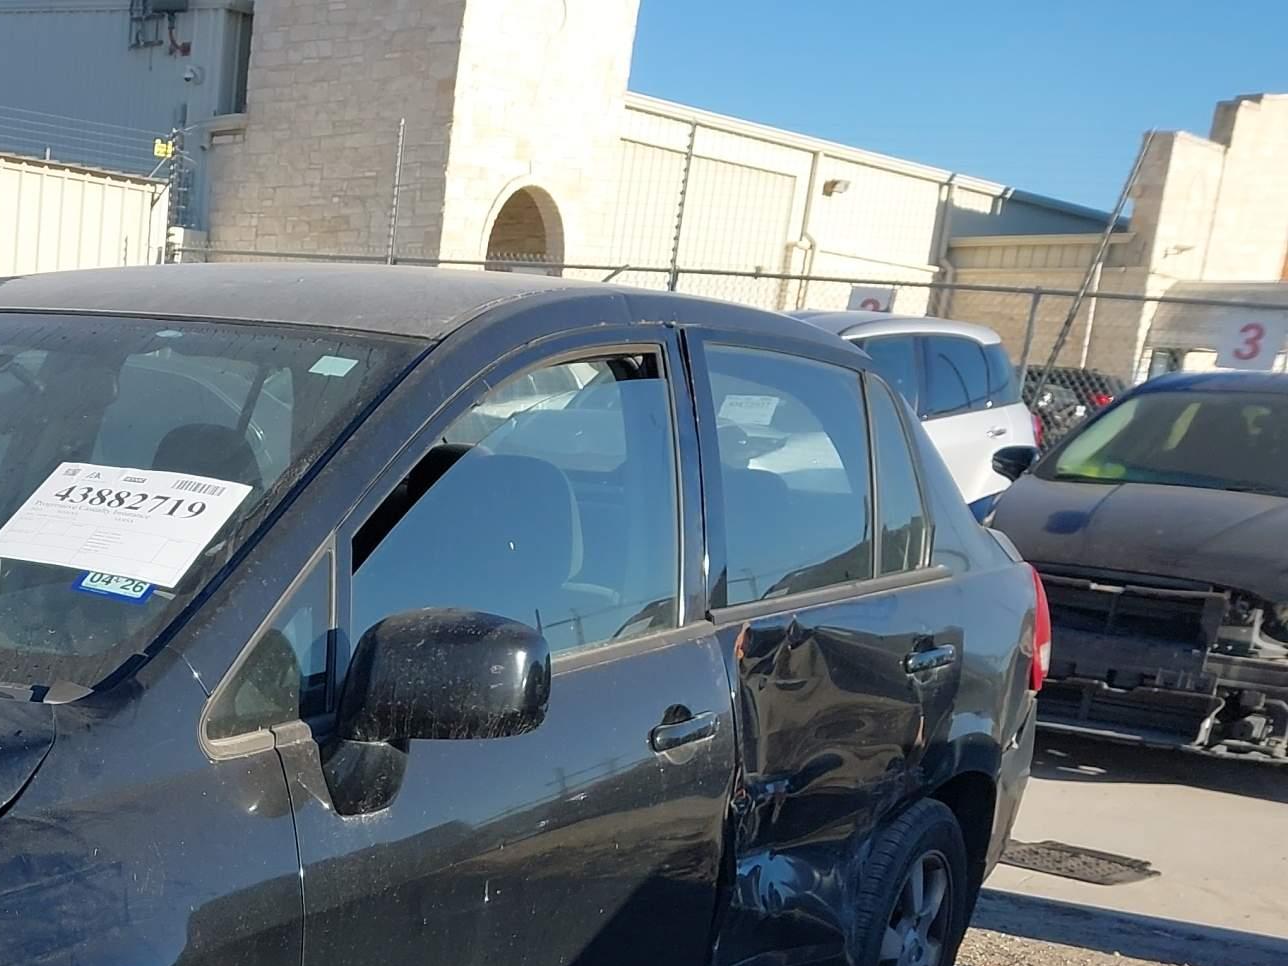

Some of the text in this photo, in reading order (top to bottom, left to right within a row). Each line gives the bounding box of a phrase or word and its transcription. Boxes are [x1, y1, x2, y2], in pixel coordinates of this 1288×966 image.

[1233, 322, 1265, 360] 3
[54, 484, 207, 519] 43882719
[119, 577, 145, 594] 26
